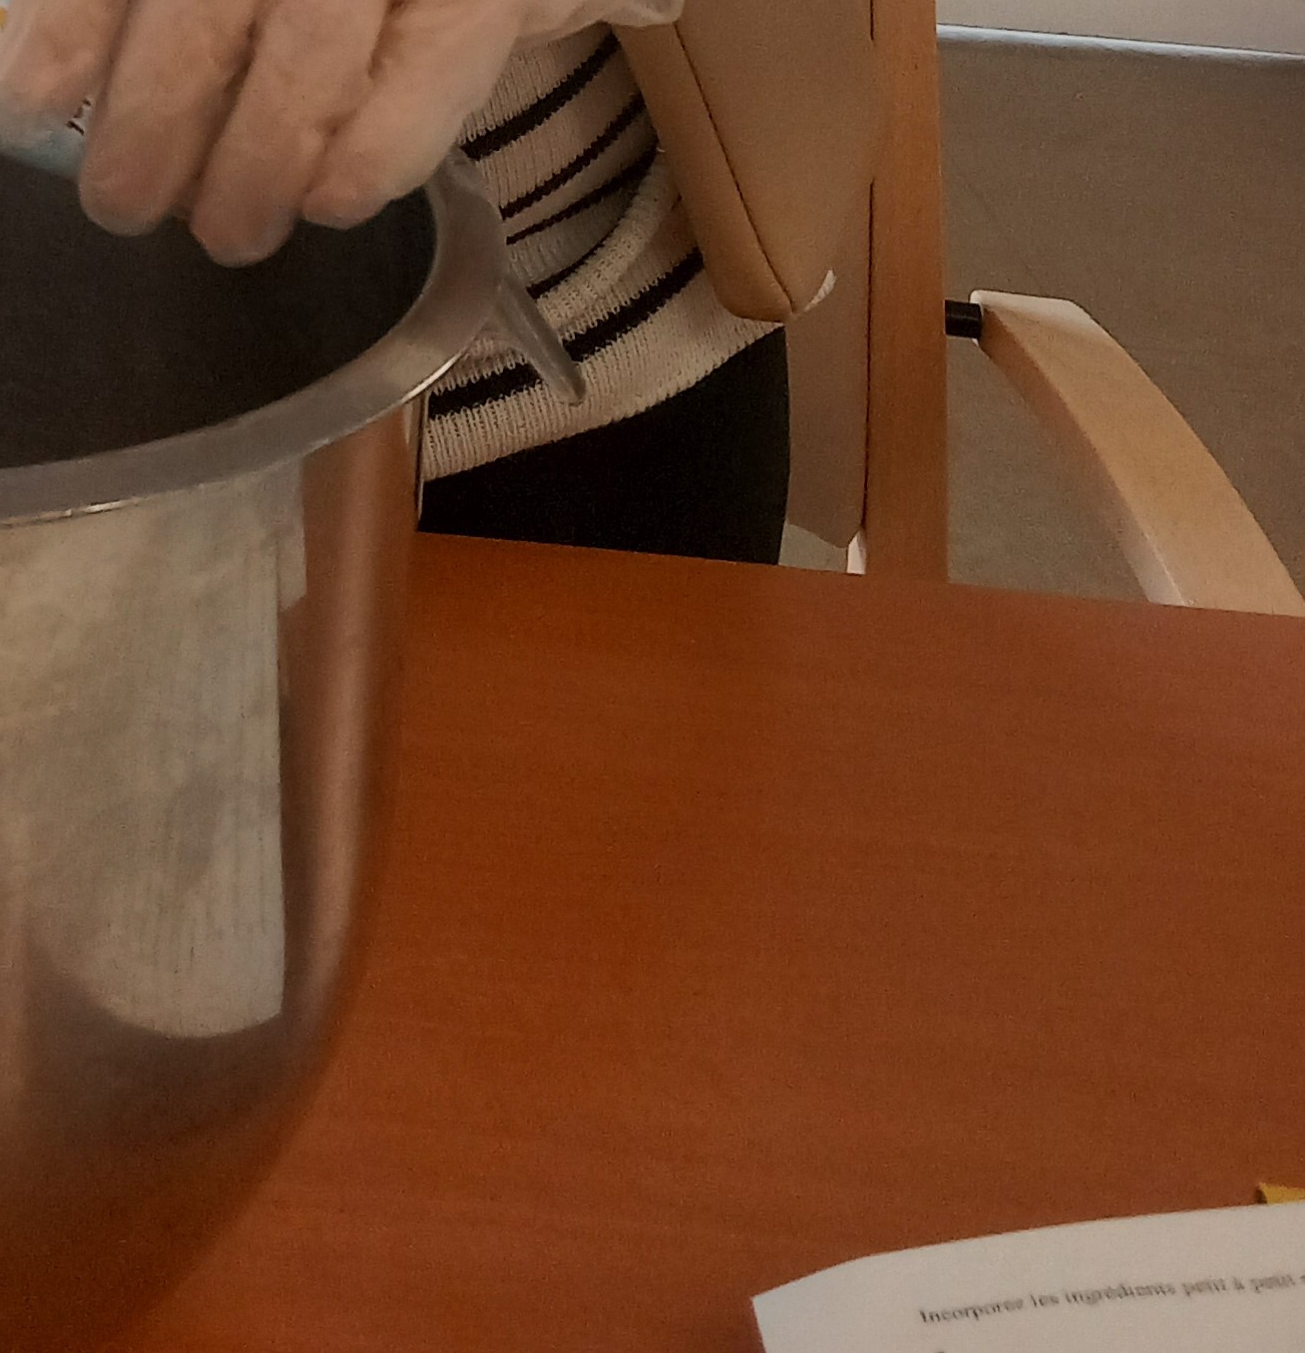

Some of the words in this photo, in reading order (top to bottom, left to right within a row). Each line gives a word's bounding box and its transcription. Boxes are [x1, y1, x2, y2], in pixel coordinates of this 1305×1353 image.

[919, 1297, 1024, 1323] Incorporer
[1030, 1293, 1059, 1308] les
[1065, 1282, 1177, 1305] ingrédients
[1183, 1276, 1226, 1297] petit
